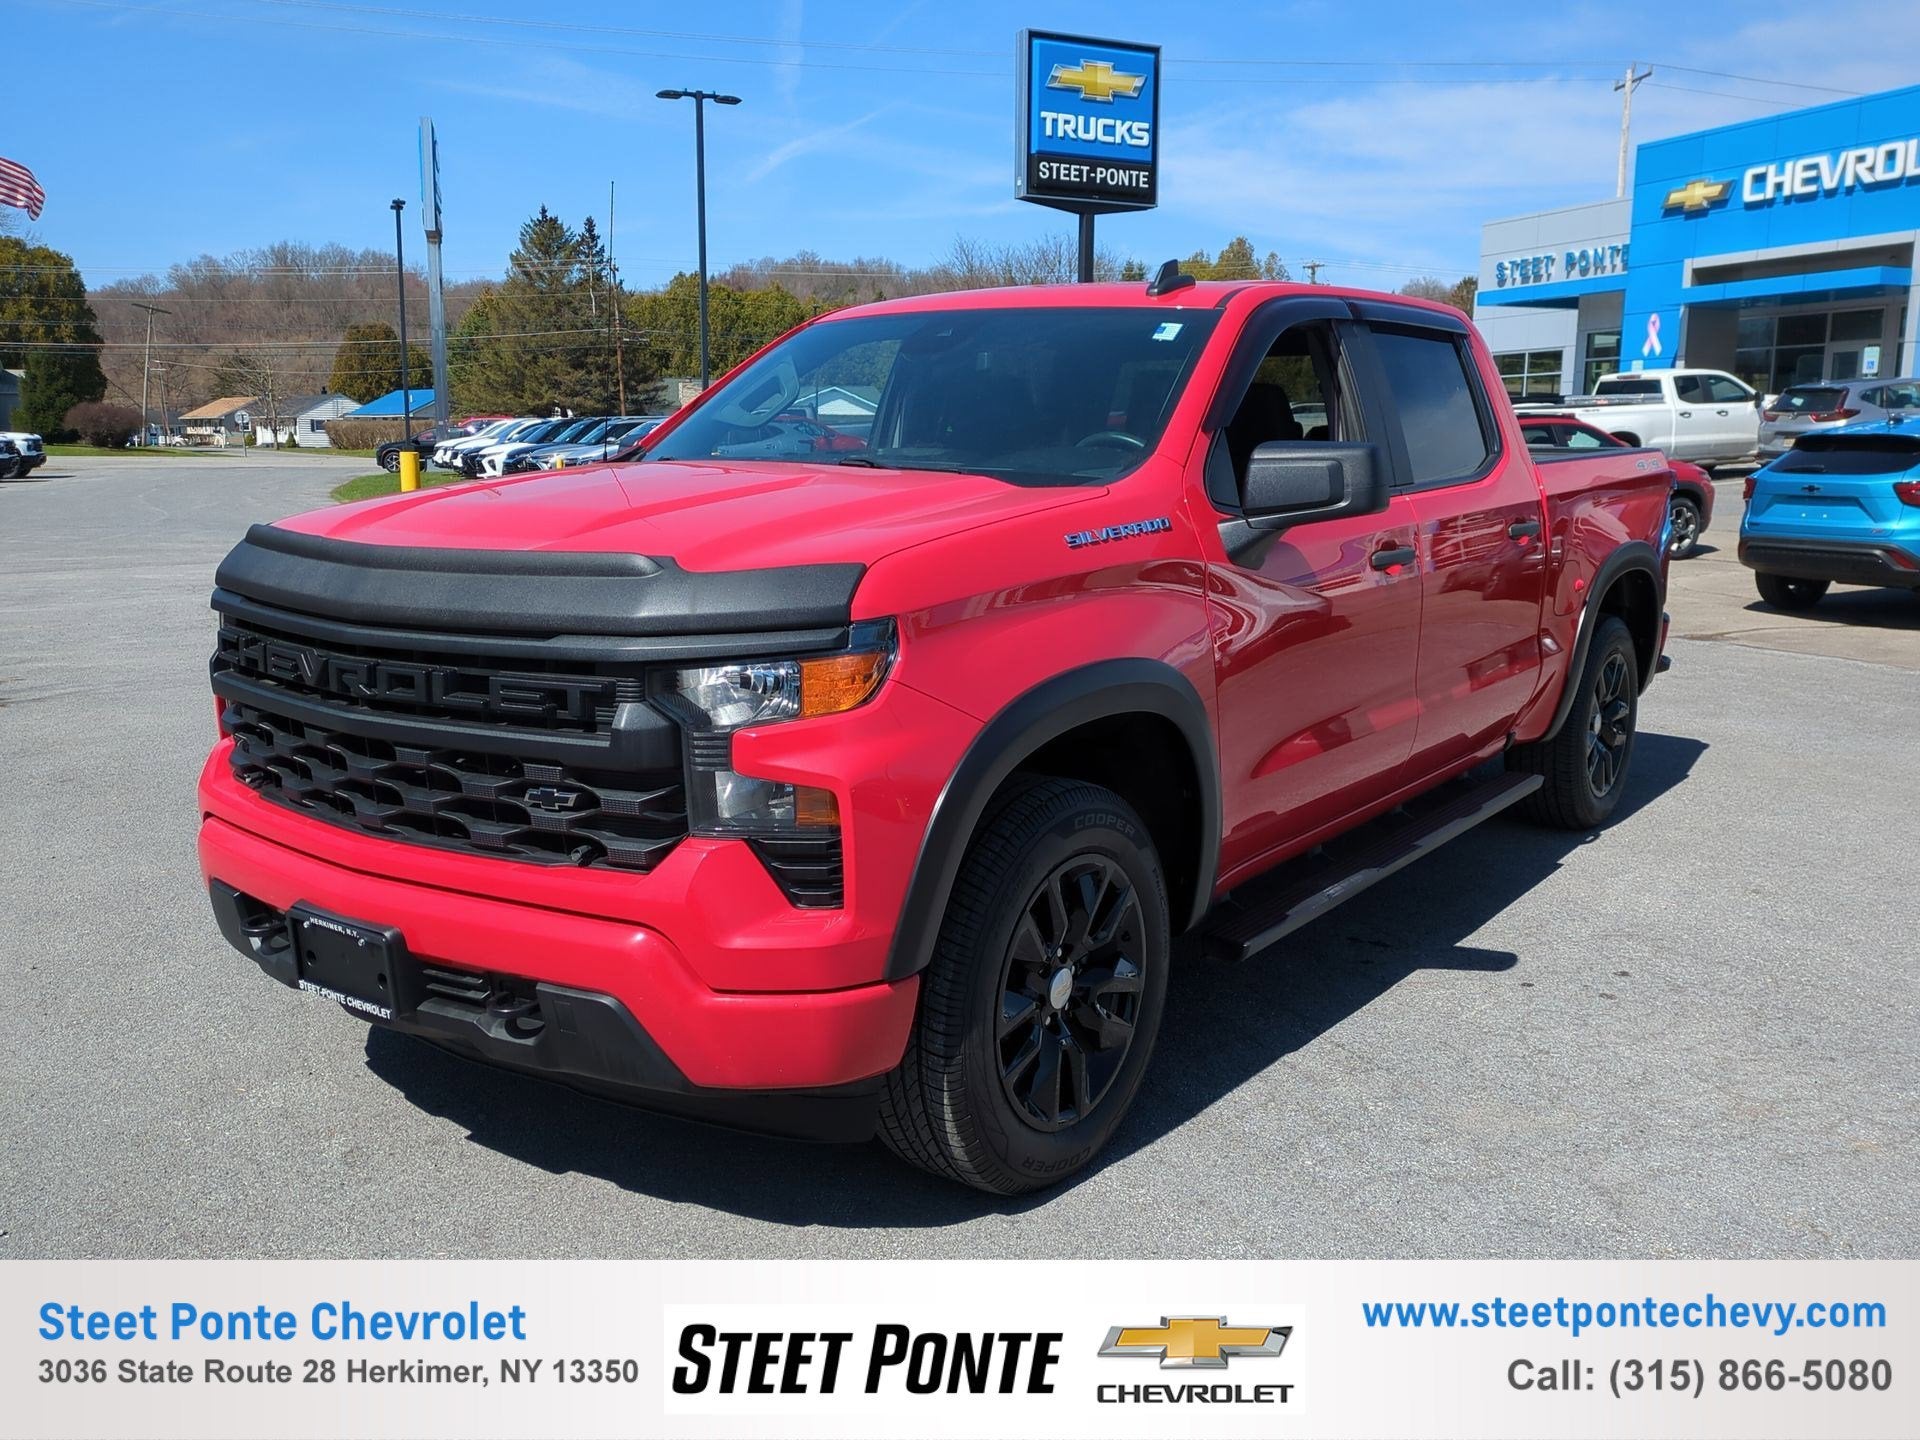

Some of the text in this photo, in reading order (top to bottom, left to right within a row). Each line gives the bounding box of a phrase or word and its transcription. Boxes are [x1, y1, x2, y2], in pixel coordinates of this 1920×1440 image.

[1040, 111, 1150, 147] TRUCKS
[1038, 161, 1150, 188] STEET-PONTE
[1496, 255, 1553, 281] STEET
[1064, 517, 1171, 547] SILVERADO
[219, 628, 617, 718] CHEVROLET
[1073, 813, 1136, 836] COOPER
[298, 979, 392, 1020] STEET-PONTE CHEVROLET
[1021, 1146, 1092, 1174] COOPER
